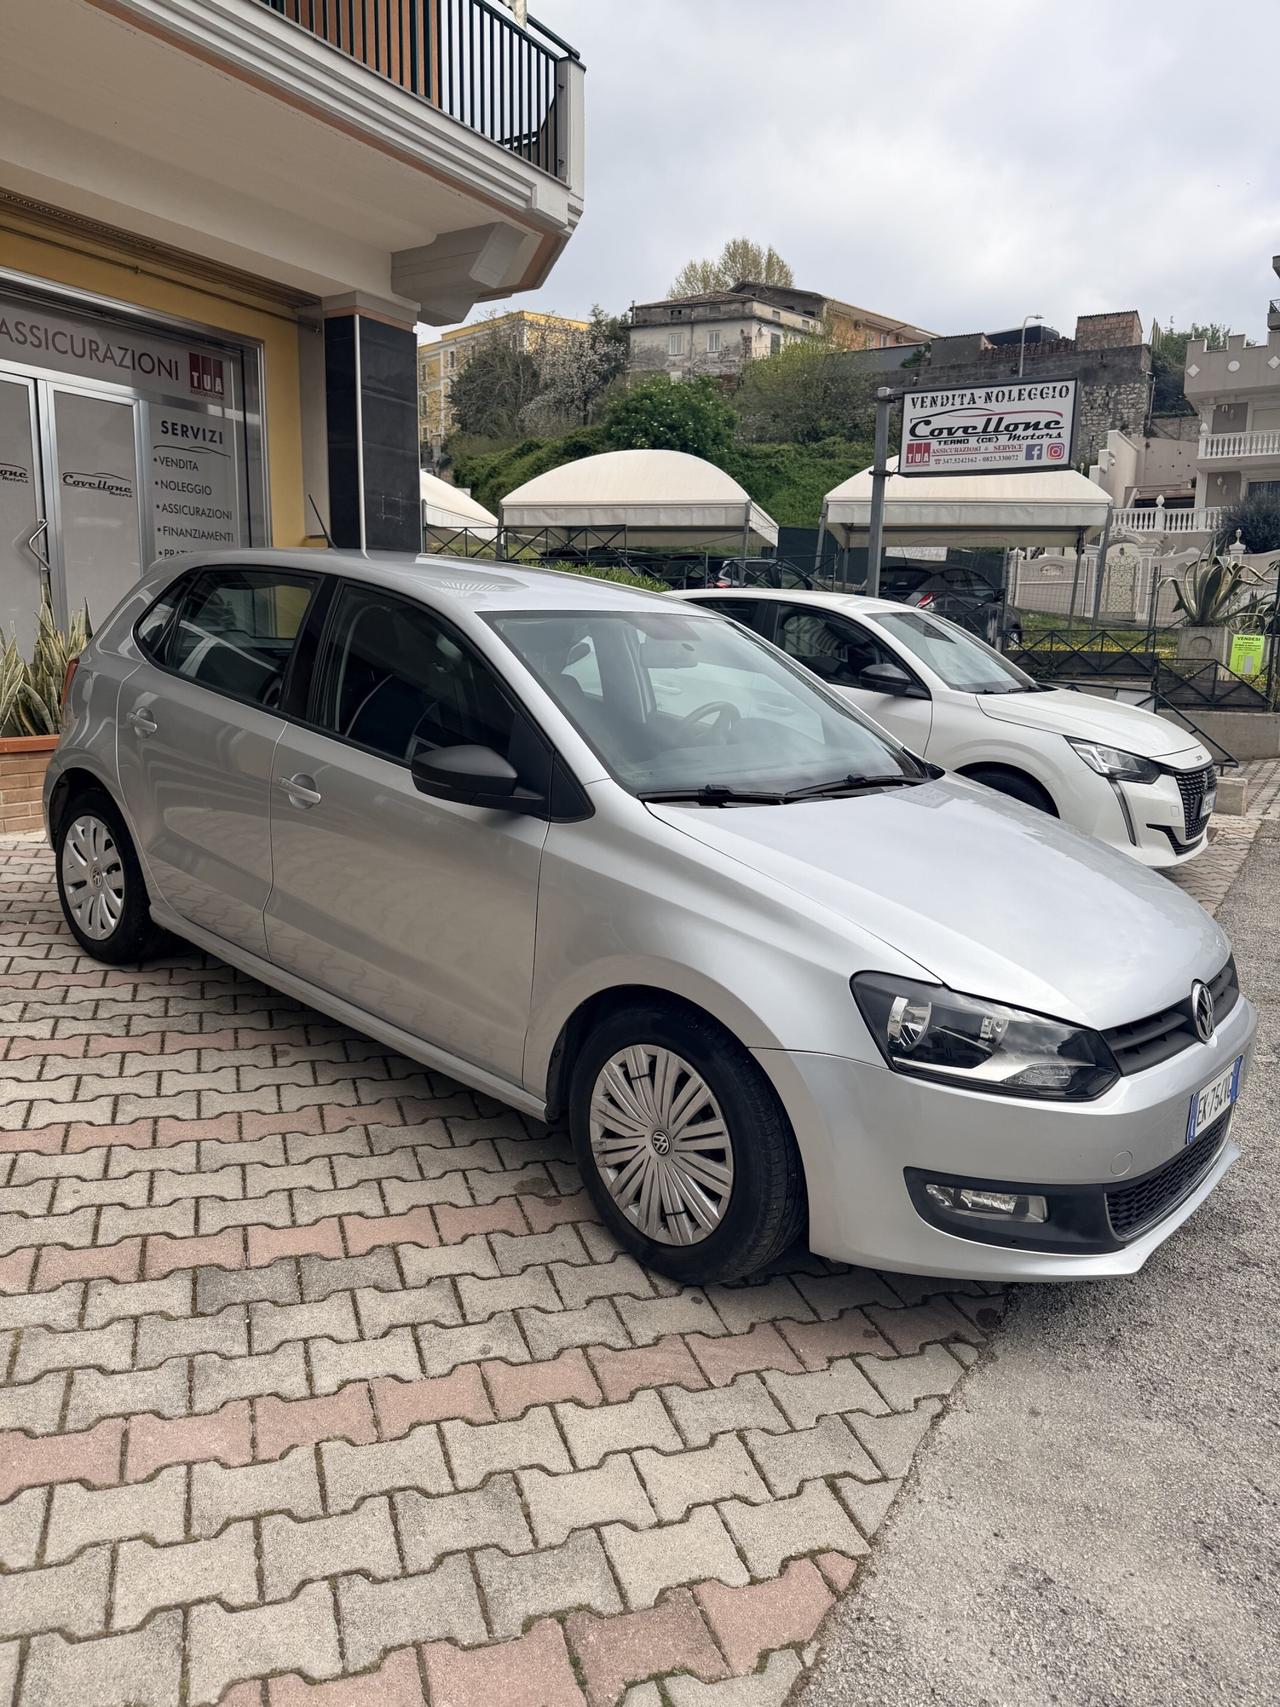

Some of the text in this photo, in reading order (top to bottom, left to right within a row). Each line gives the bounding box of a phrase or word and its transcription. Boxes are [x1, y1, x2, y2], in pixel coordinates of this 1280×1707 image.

[0, 317, 179, 381] ASSICURAZIONI
[192, 371, 223, 393] TUA
[161, 420, 223, 445] SERVIZI
[909, 416, 1064, 438] Covellone
[976, 435, 999, 445] (CE)
[158, 456, 199, 471] VENDITA
[908, 452, 929, 463] TUA
[62, 474, 133, 494] Covellone
[160, 480, 213, 496] NOLEGGIO
[162, 503, 233, 521] ASSICURAZIONI
[163, 526, 234, 543] FINANZIAMENTI
